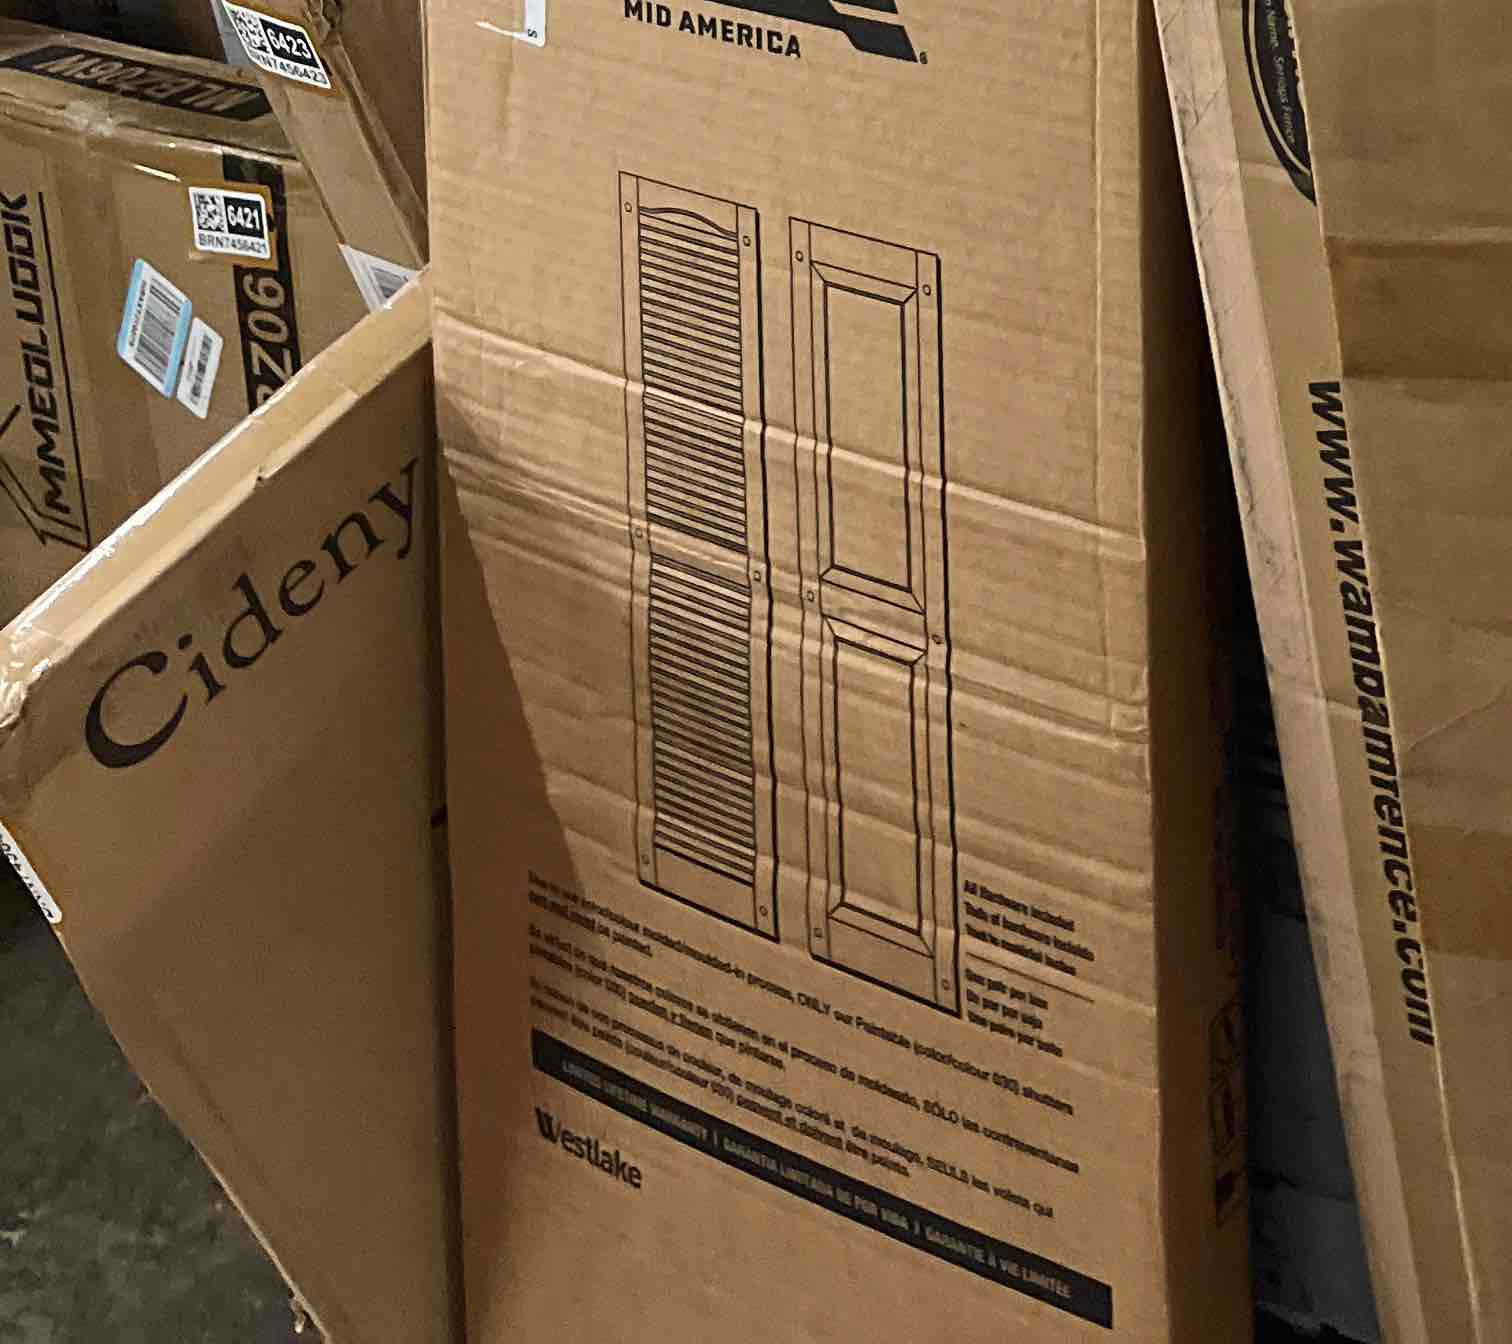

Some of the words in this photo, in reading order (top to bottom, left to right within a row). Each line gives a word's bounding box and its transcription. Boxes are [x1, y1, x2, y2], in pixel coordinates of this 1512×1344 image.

[267, 28, 312, 60] 6423
[679, 10, 802, 59] AMERICA
[226, 204, 261, 234] 6421
[198, 232, 270, 256] BRN7456421
[85, 455, 420, 770] Cideny
[534, 1104, 643, 1189] Westlake
